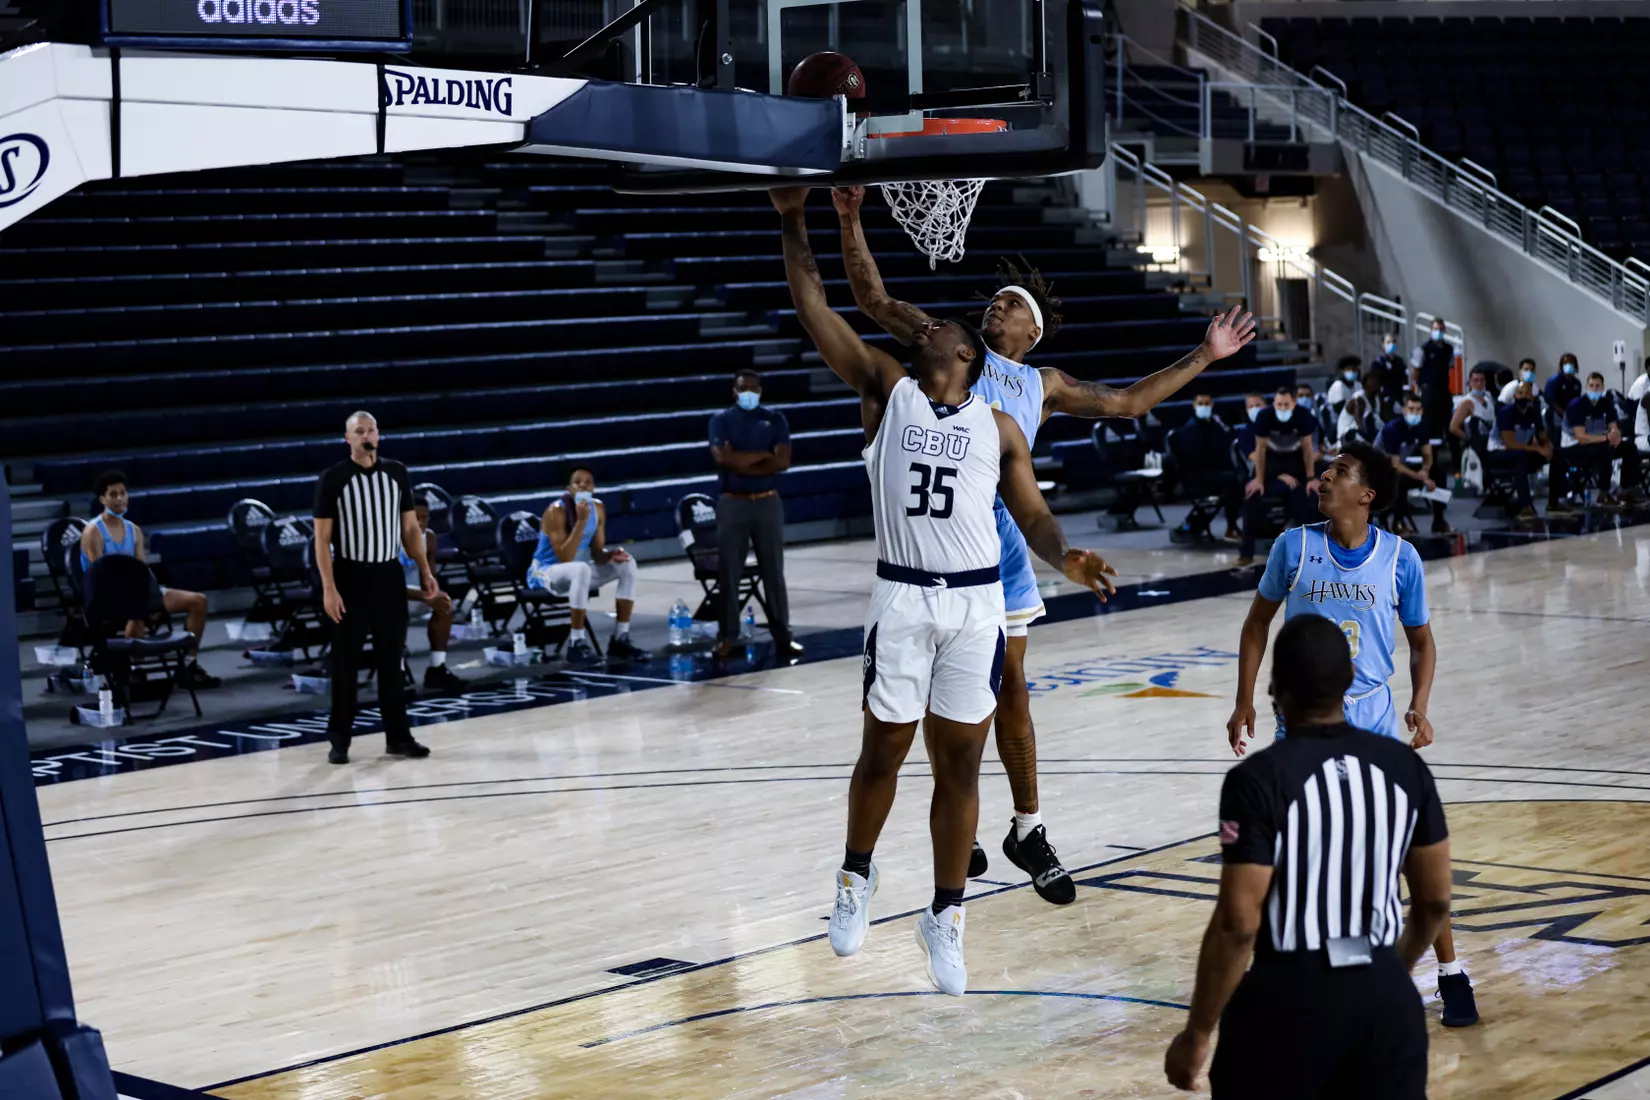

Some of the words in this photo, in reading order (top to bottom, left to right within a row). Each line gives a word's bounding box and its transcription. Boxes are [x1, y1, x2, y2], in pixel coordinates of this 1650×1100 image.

[197, 0, 320, 25] adidas
[901, 424, 971, 461] CBU
[953, 425, 970, 434] WAC
[905, 462, 958, 519] 35
[1301, 580, 1376, 611] HAWKS
